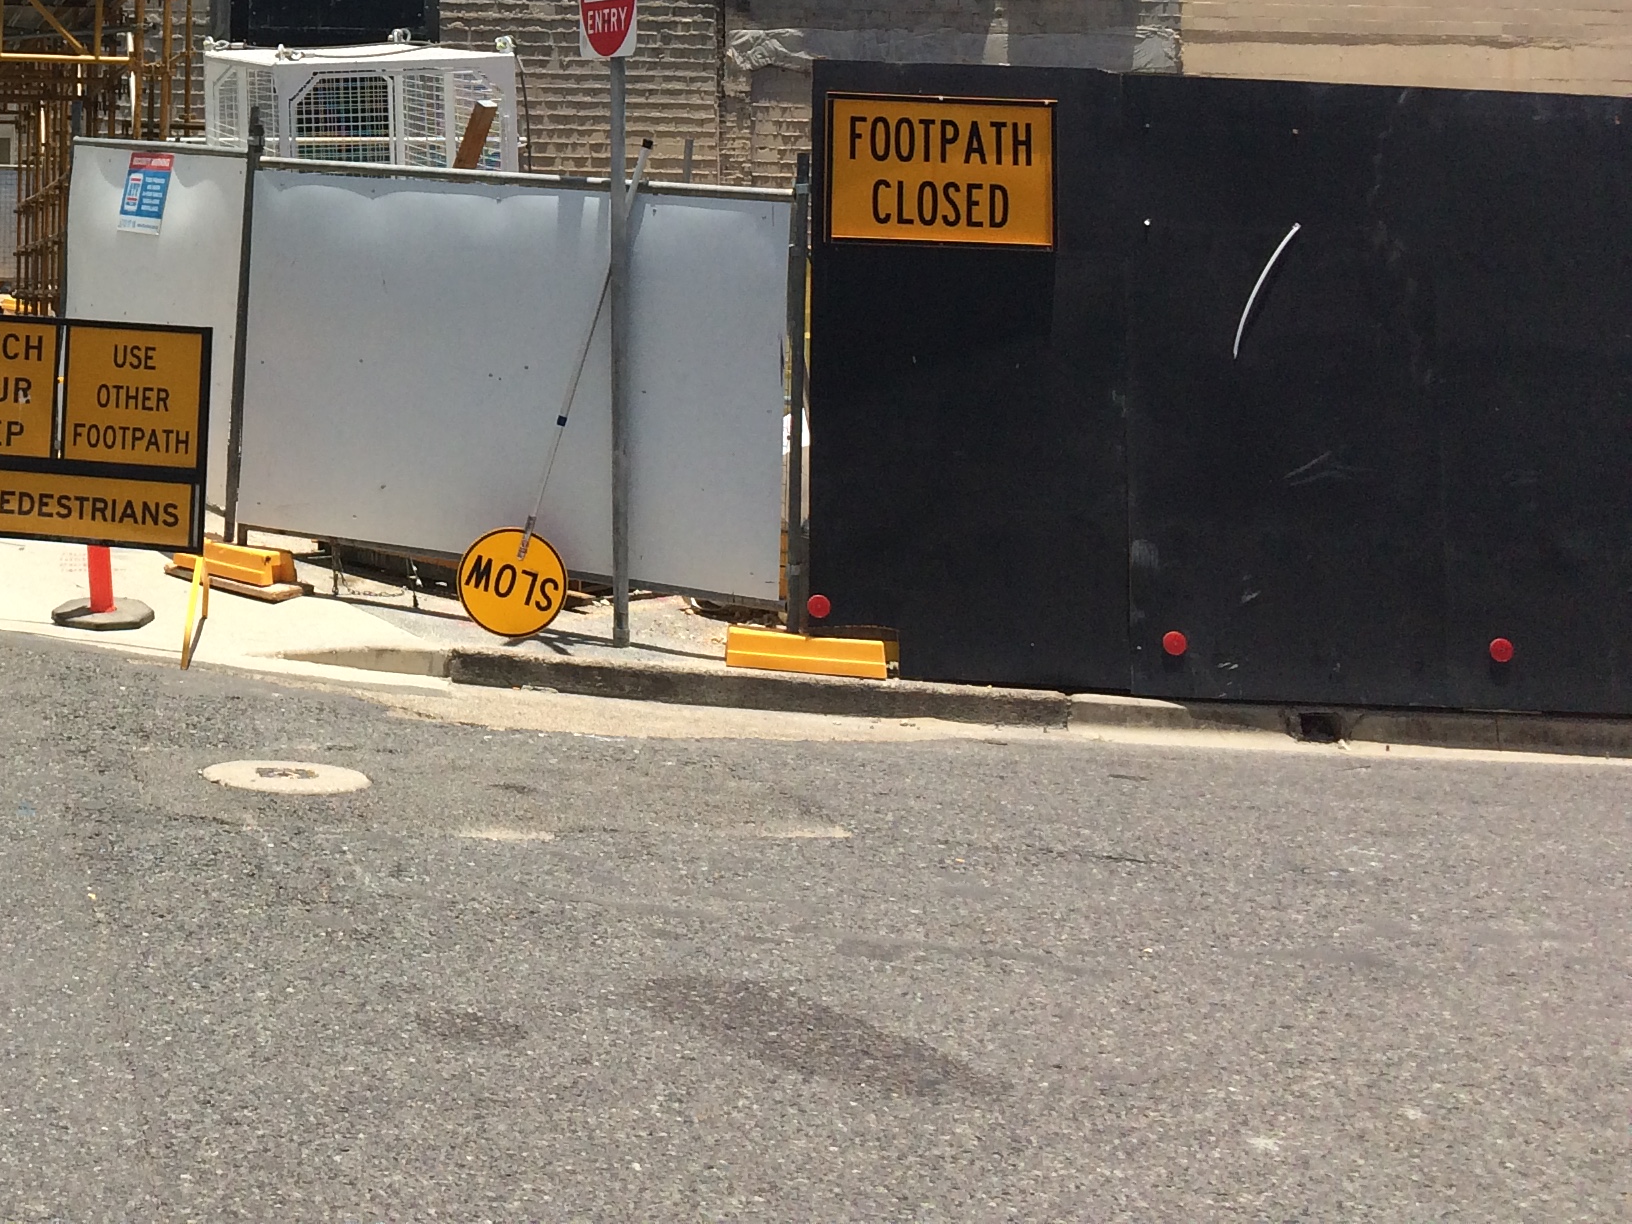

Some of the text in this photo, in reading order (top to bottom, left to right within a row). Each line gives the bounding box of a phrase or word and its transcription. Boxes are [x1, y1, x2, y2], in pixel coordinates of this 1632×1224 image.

[587, 6, 628, 35] ENTRY
[849, 115, 1033, 167] FOOTPATH
[871, 178, 1010, 229] CLOSED
[112, 343, 157, 371] USE
[96, 383, 171, 413] OTHER
[72, 422, 191, 455] FOOTPATH
[463, 554, 560, 612] SLOW
